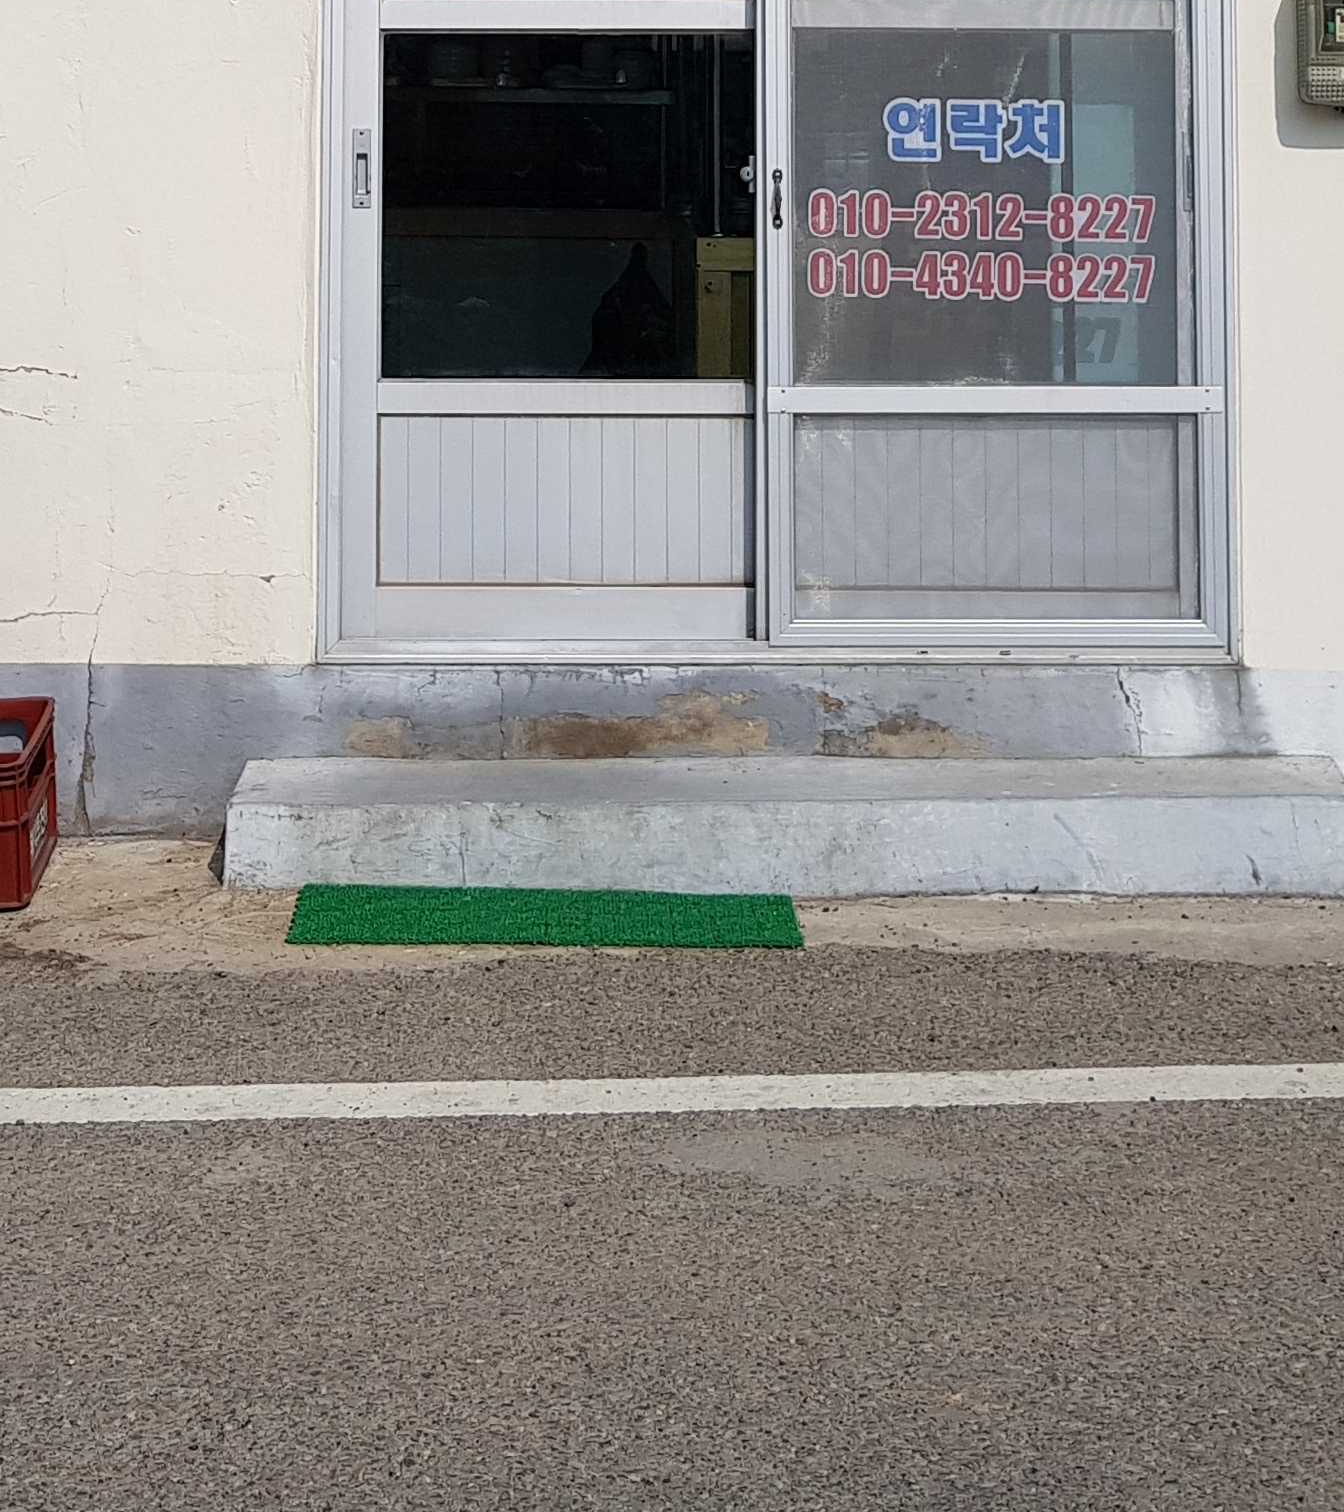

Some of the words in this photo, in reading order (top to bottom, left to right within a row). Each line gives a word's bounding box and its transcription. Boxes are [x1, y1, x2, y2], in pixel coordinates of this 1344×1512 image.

[883, 97, 1065, 163] 연락처
[808, 188, 1156, 242] 010-2312-8227
[808, 248, 1156, 303] 010-4340-8227
